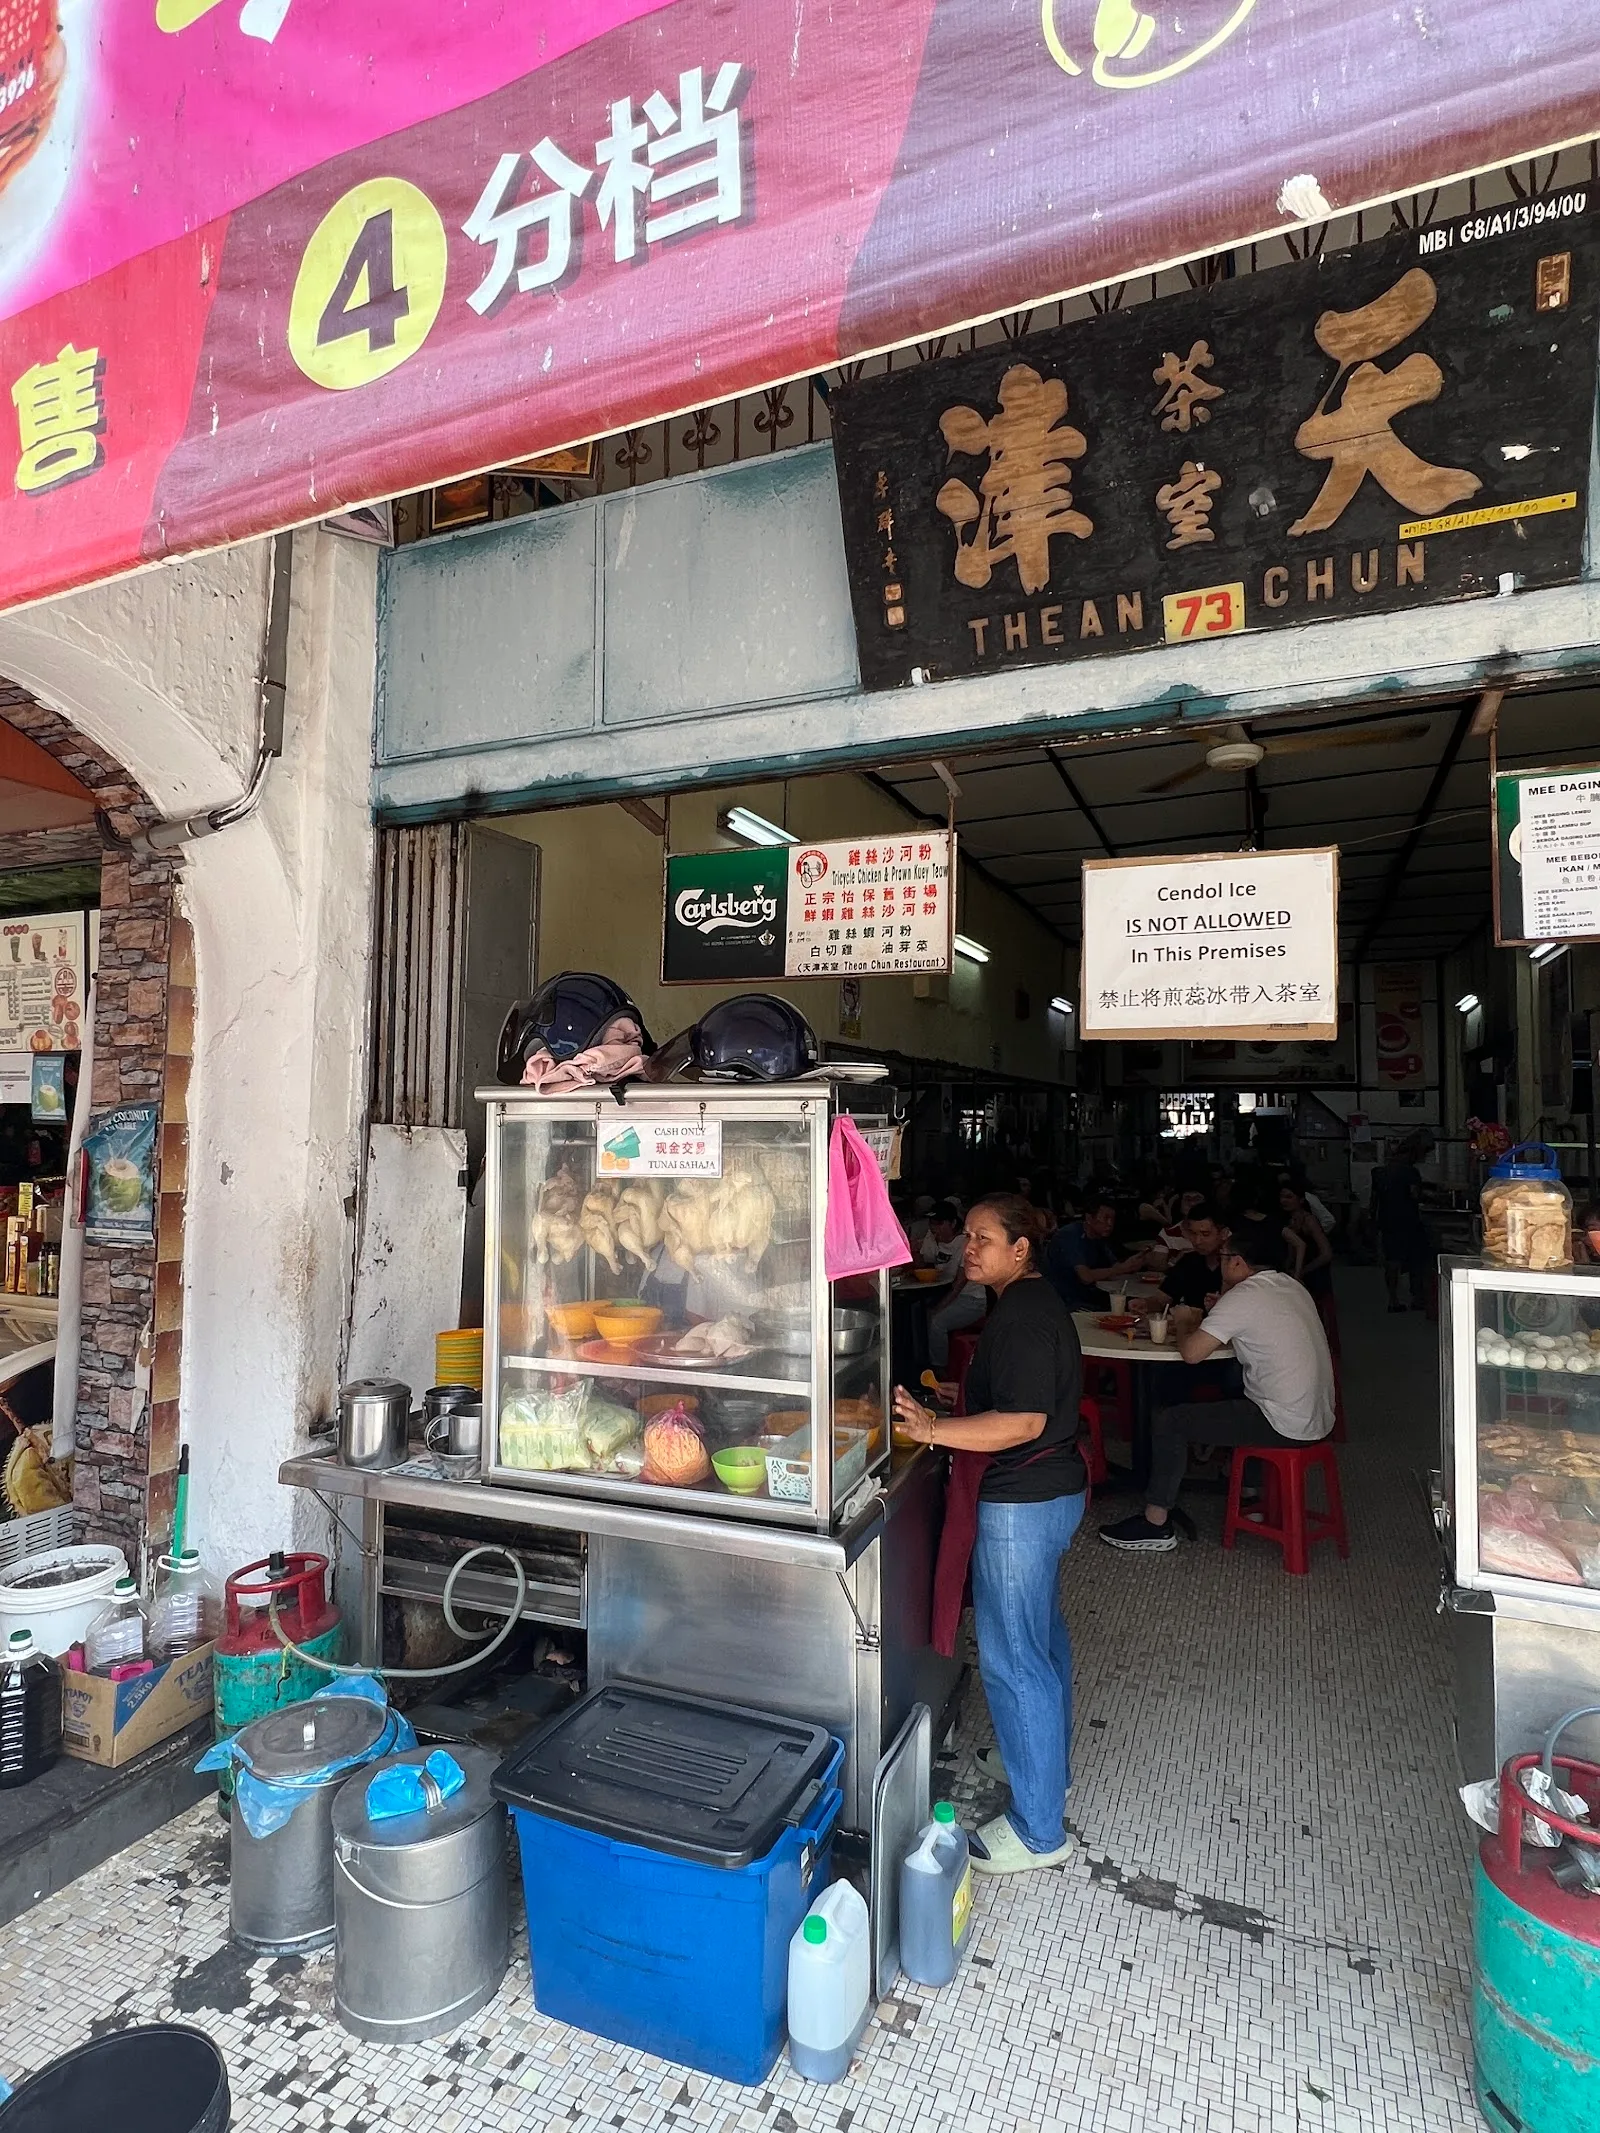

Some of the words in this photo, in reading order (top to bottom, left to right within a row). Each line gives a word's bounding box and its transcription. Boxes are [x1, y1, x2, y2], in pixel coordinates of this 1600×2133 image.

[316, 209, 410, 353] 4
[462, 62, 744, 317] 分档
[1460, 192, 1587, 244] G8/A1/3/94/00
[1287, 267, 1484, 537] 天
[12, 342, 102, 492] 售
[1263, 540, 1426, 608] CHUN
[968, 590, 1146, 656] THEAN
[1175, 592, 1233, 635] 73
[1528, 785, 1556, 796] MEE
[1546, 856, 1567, 864] MEE
[1559, 865, 1584, 873] IKAN
[857, 868, 882, 885] Chicken
[1157, 882, 1222, 902] Cendol
[1229, 883, 1257, 897] Ice
[675, 885, 777, 934] Carlsberg
[1126, 919, 1141, 934] IS
[1148, 915, 1189, 932] NOT
[1194, 910, 1292, 930] ALLOWED
[1131, 949, 1148, 963] In
[1154, 946, 1192, 962] This
[1199, 942, 1287, 960] Premises
[871, 959, 892, 970] Chun
[1099, 982, 1321, 1009] 禁止将煎蕊冰带入茶室
[654, 1127, 679, 1136] CASH
[680, 1127, 706, 1136] ONLY
[656, 1142, 706, 1154] 现金交易
[648, 1160, 677, 1169] TUNAI
[679, 1160, 716, 1170] SAHAJA
[65, 1687, 93, 1703] TEAPOT
